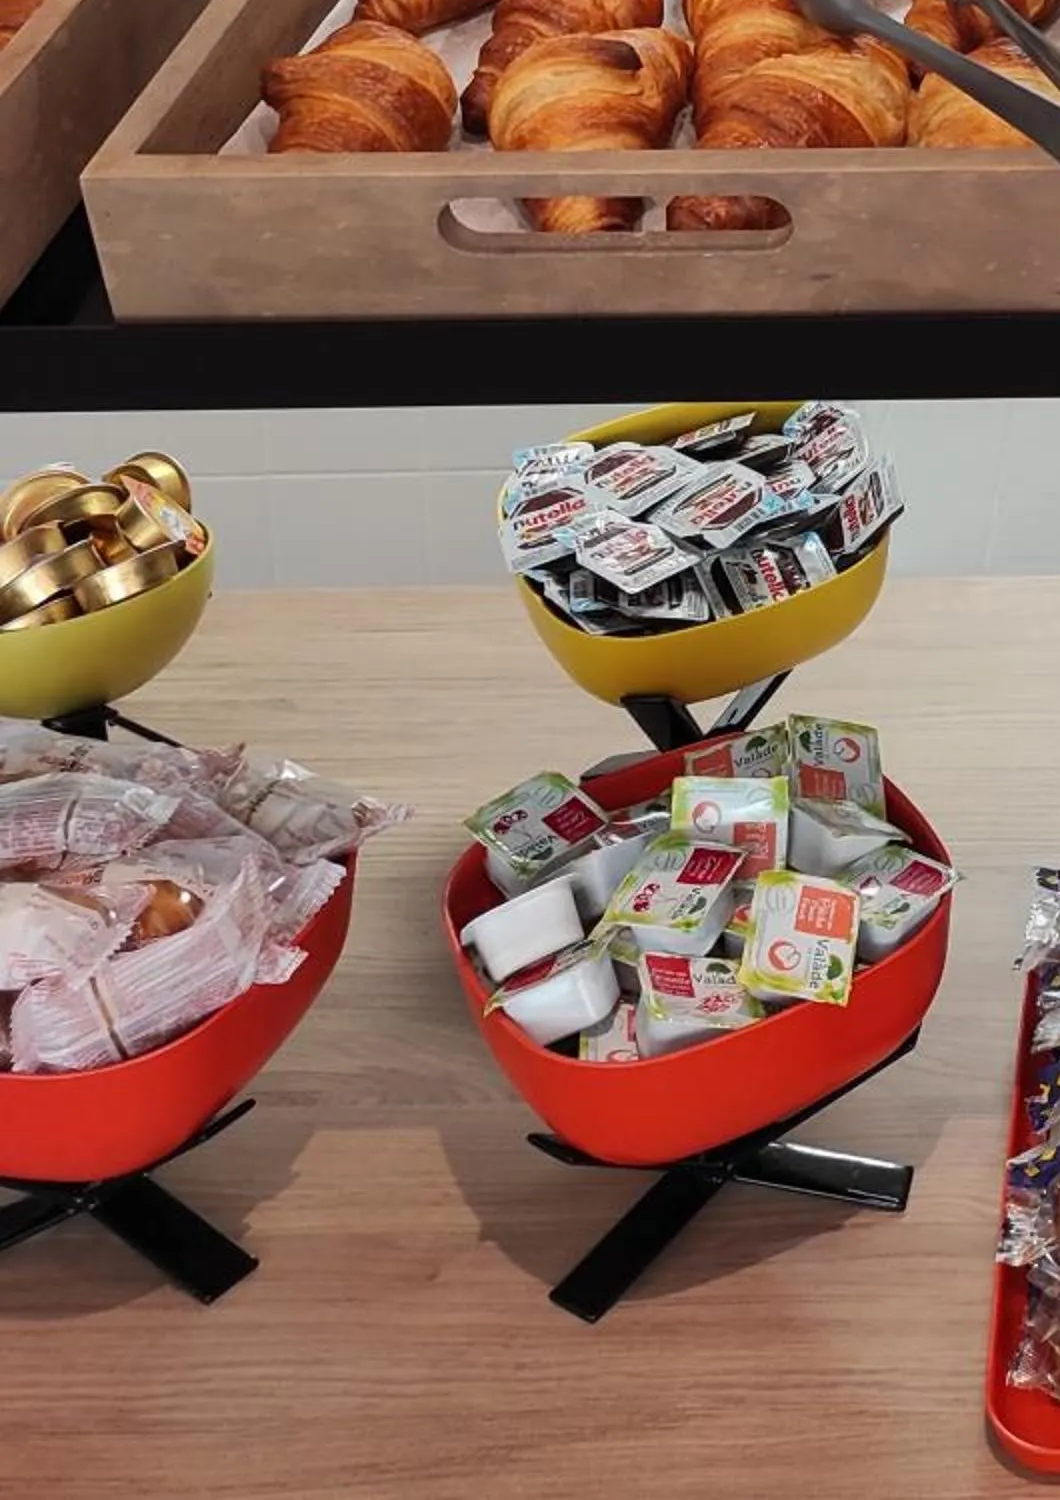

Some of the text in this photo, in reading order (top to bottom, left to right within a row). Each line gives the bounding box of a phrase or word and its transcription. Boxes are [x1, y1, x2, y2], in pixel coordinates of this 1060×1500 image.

[513, 497, 587, 531] nutella
[733, 743, 779, 768] Valade
[692, 972, 737, 985] Valad
[809, 938, 830, 990] Valade
